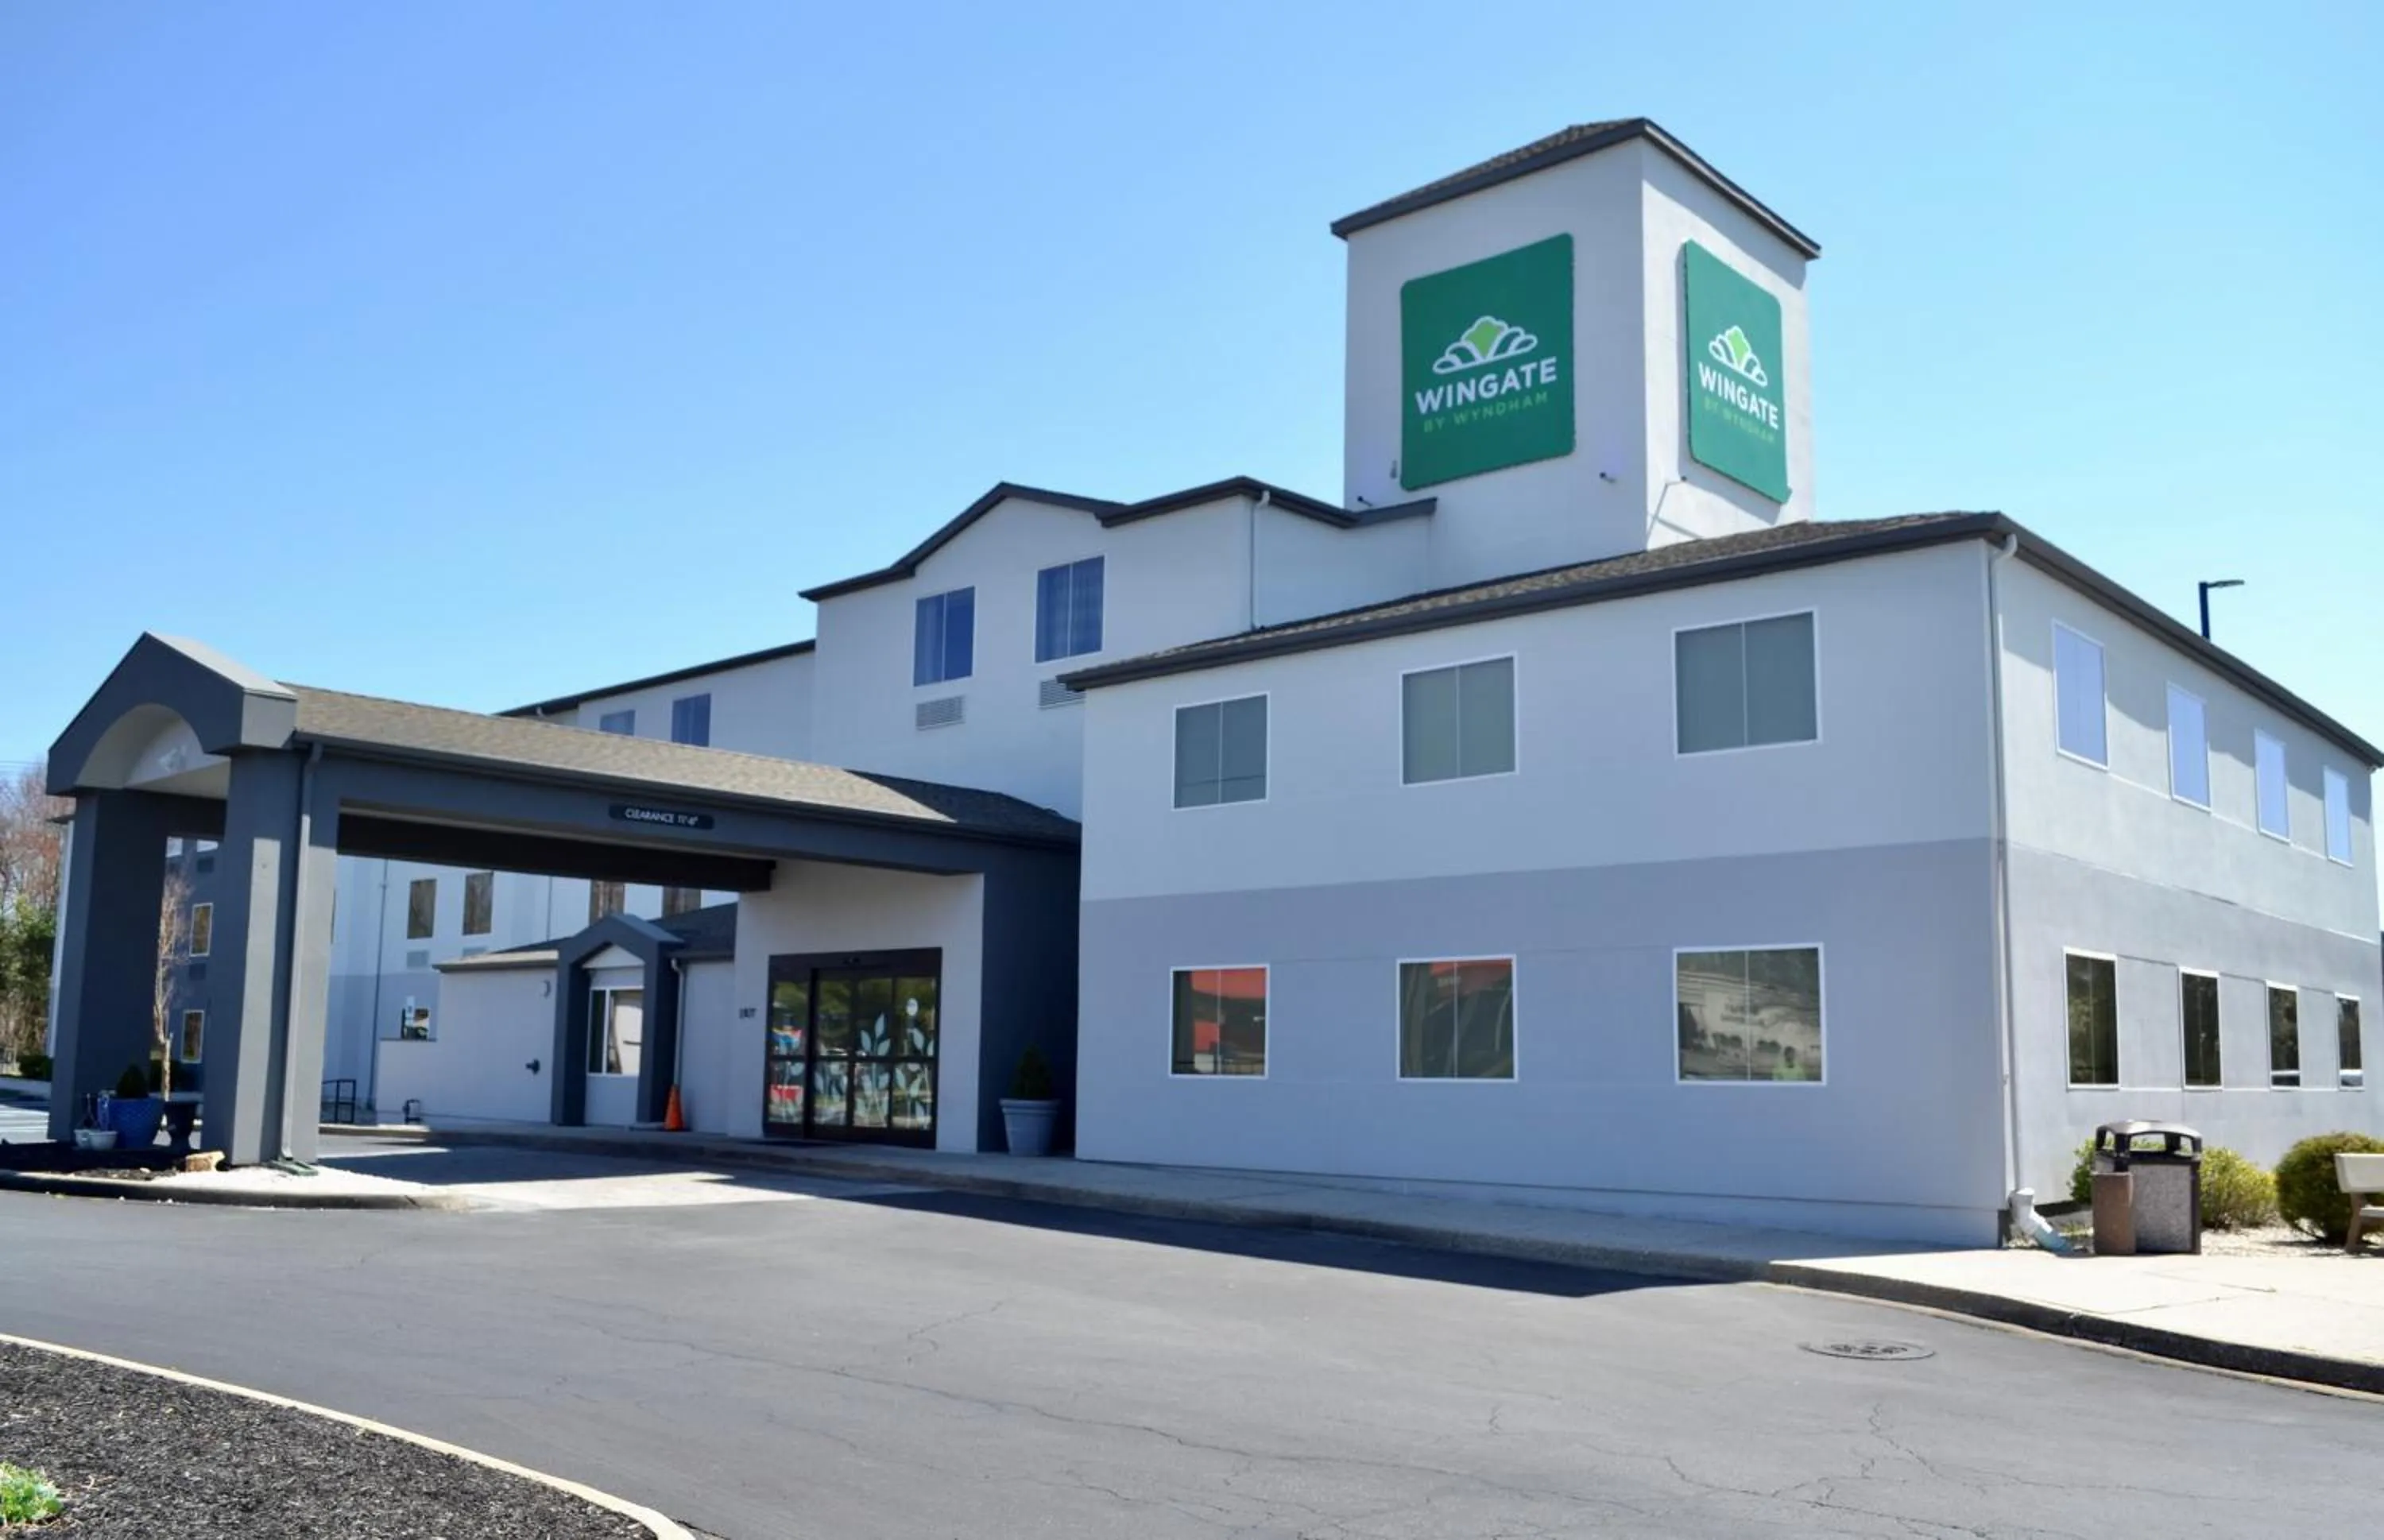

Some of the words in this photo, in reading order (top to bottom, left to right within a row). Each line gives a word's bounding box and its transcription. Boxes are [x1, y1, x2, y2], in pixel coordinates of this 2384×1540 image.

[1415, 357, 1558, 415] WINGATE
[1698, 361, 1779, 430] WINGATE
[1423, 416, 1446, 432] BY
[1453, 392, 1549, 425] WYNDHAM
[625, 808, 674, 823] CLEARANCE
